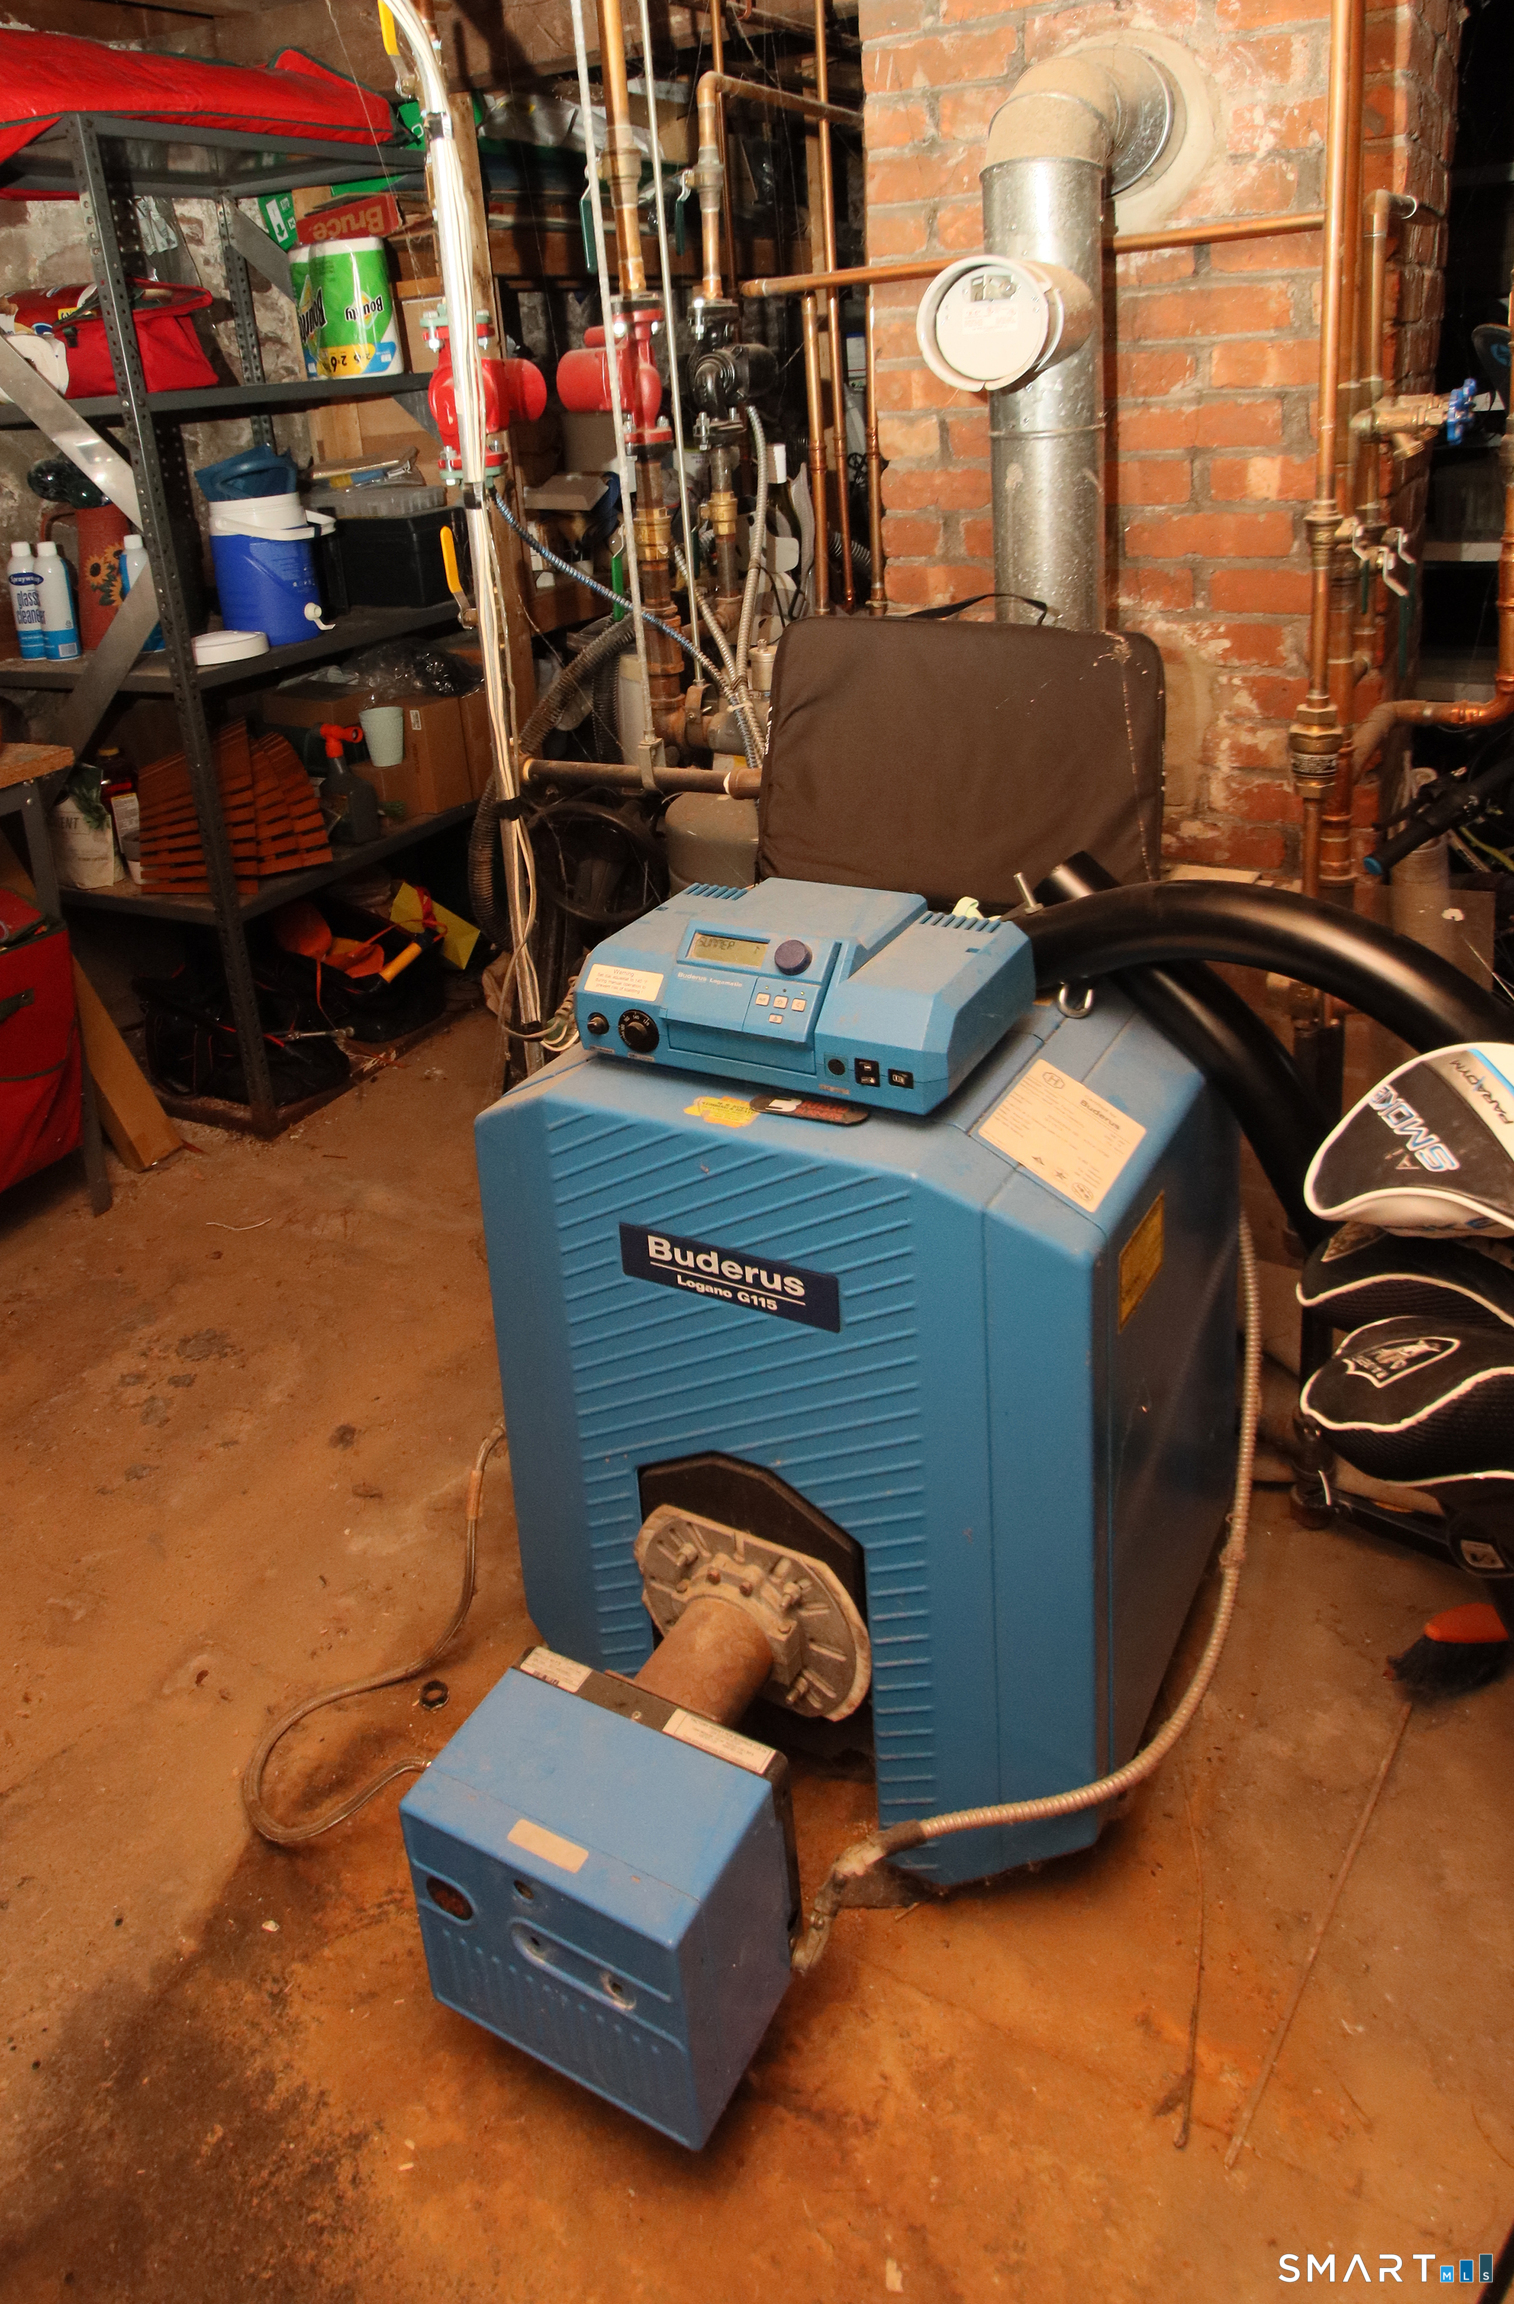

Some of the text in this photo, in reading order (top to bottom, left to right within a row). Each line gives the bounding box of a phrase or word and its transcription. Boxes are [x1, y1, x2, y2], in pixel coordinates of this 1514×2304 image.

[313, 206, 384, 240] Bruce
[345, 295, 384, 321] Bouty
[677, 972, 707, 983] Buderus
[1080, 1099, 1121, 1131] Buderus
[647, 1235, 806, 1297] Buderus
[677, 1275, 778, 1311] Logano G115
